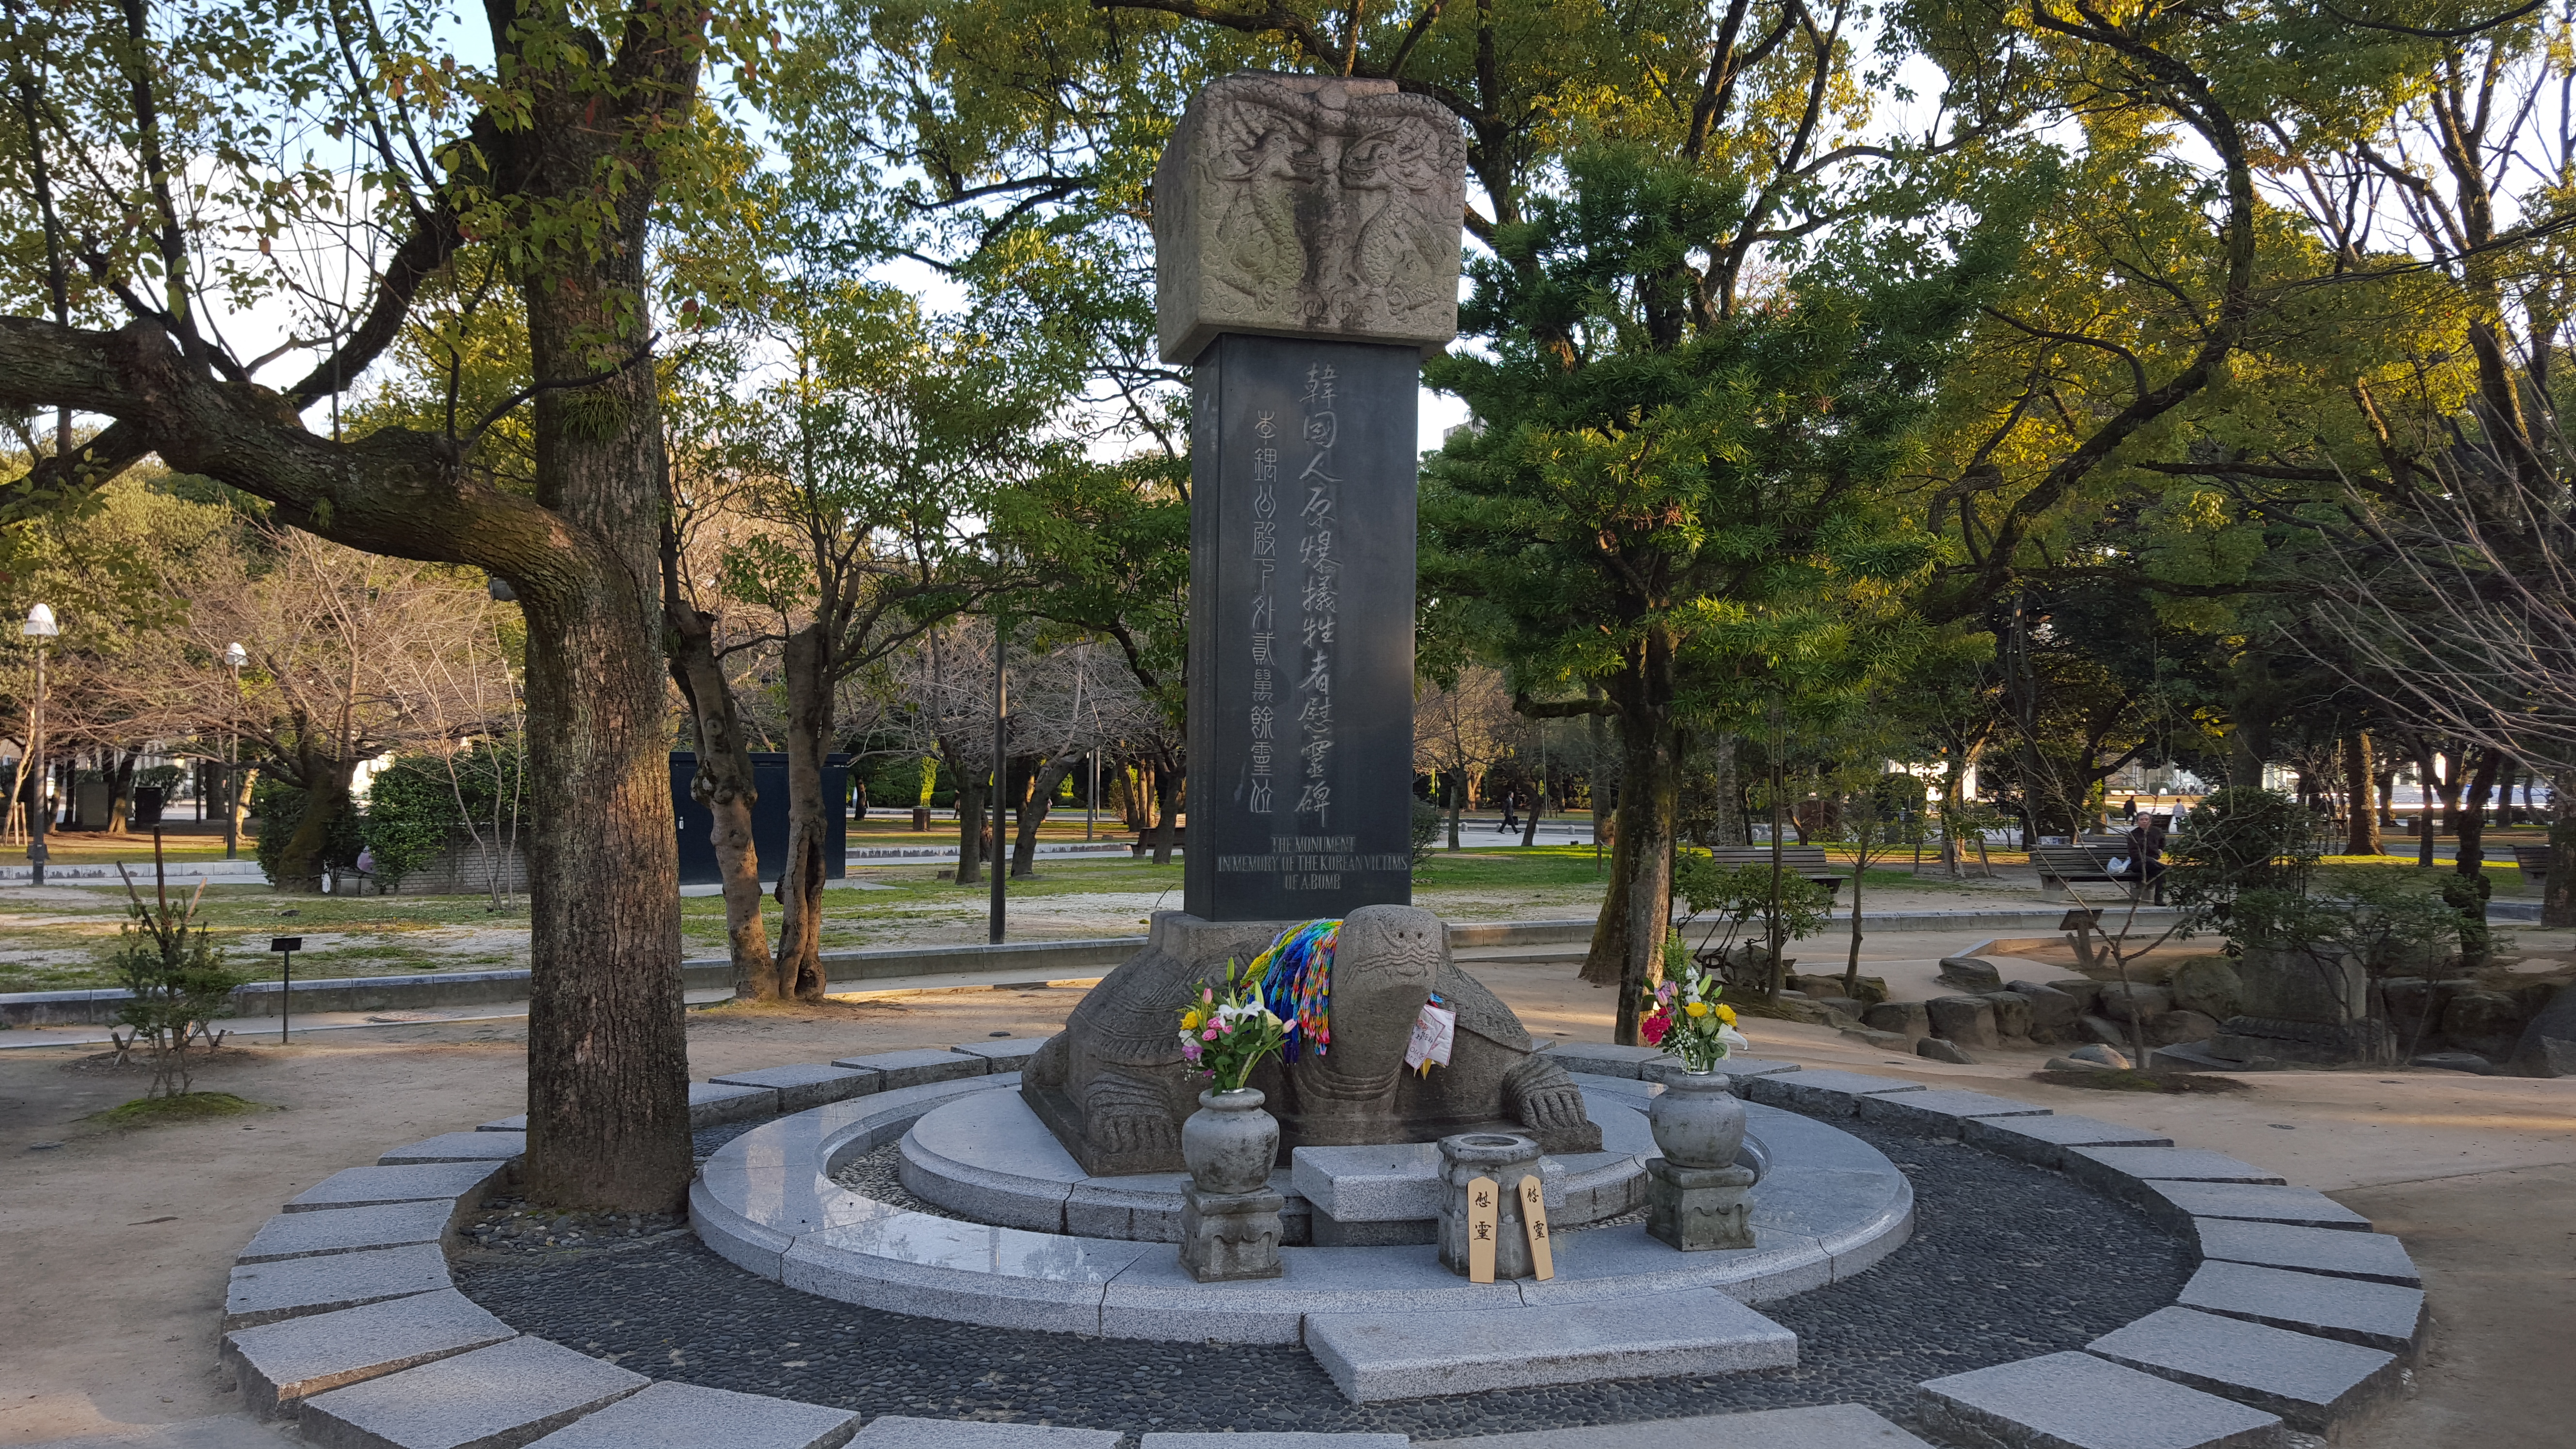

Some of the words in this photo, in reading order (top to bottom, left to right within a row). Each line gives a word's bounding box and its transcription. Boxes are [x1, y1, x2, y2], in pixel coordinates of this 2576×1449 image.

[1271, 837, 1292, 853] THE
[1295, 836, 1355, 853] MONUMENT
[1218, 856, 1231, 872] IN
[1232, 855, 1278, 872] MEMORY
[1282, 855, 1295, 871] OF
[1298, 855, 1319, 871] THE
[1320, 854, 1363, 871] KOREAN
[1364, 854, 1408, 871] VICTIMS
[1285, 874, 1299, 890] OF
